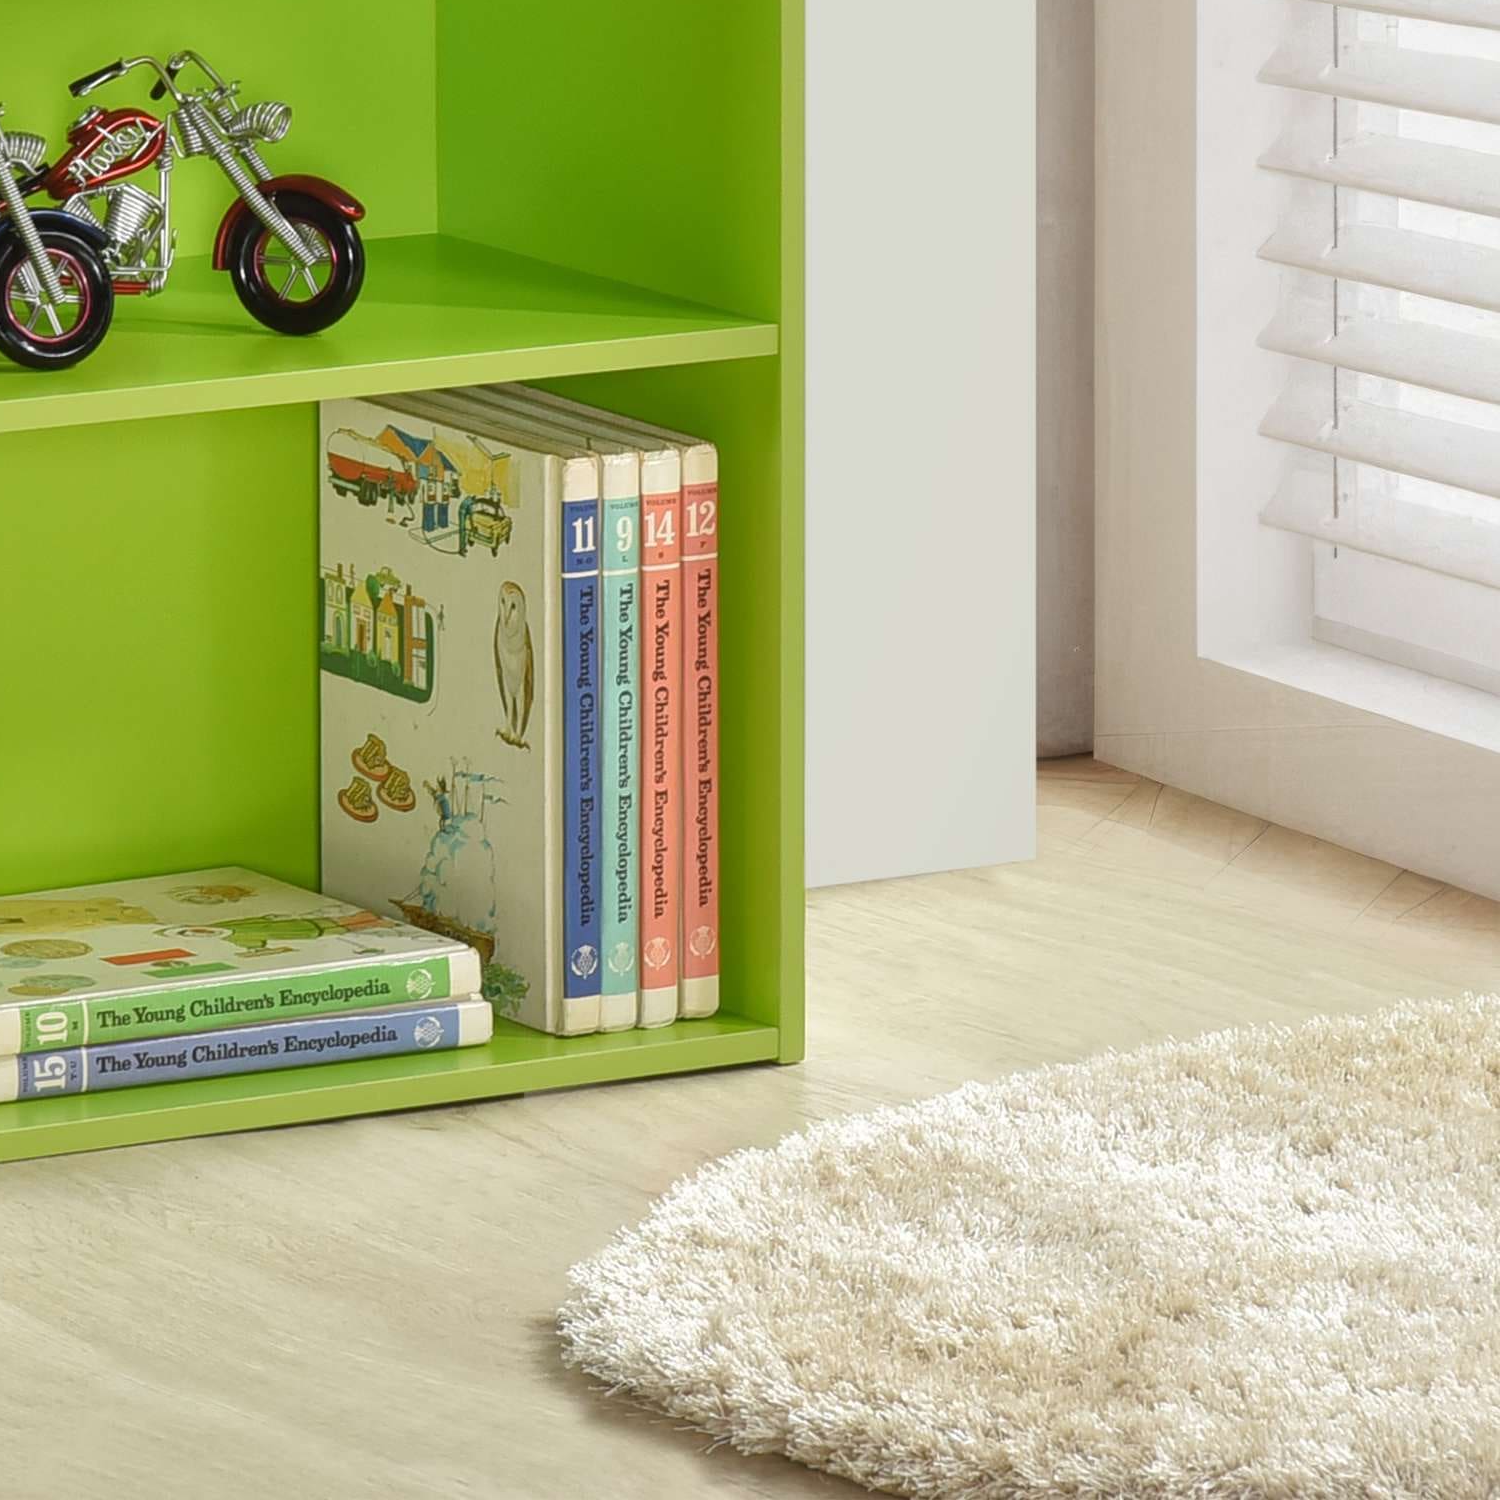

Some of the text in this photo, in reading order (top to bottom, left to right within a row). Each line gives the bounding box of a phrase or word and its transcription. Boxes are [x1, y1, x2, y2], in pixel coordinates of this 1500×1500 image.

[572, 516, 596, 553] 11
[616, 516, 633, 552] 9
[644, 510, 675, 548] 14
[686, 500, 716, 538] 12
[577, 585, 595, 927] The Young Children's Encyclopedia
[615, 583, 633, 924] The Young Children's Encyclopedia
[652, 580, 670, 919] The Young Children's Encyclopedia
[695, 568, 712, 908] The Young Children's Encyclopedia
[97, 978, 391, 1028] The Young Children's Encyclopedia
[36, 1011, 68, 1045] 10
[96, 1025, 398, 1074] The Young Children's Encyclopedia
[33, 1055, 66, 1092] 15
